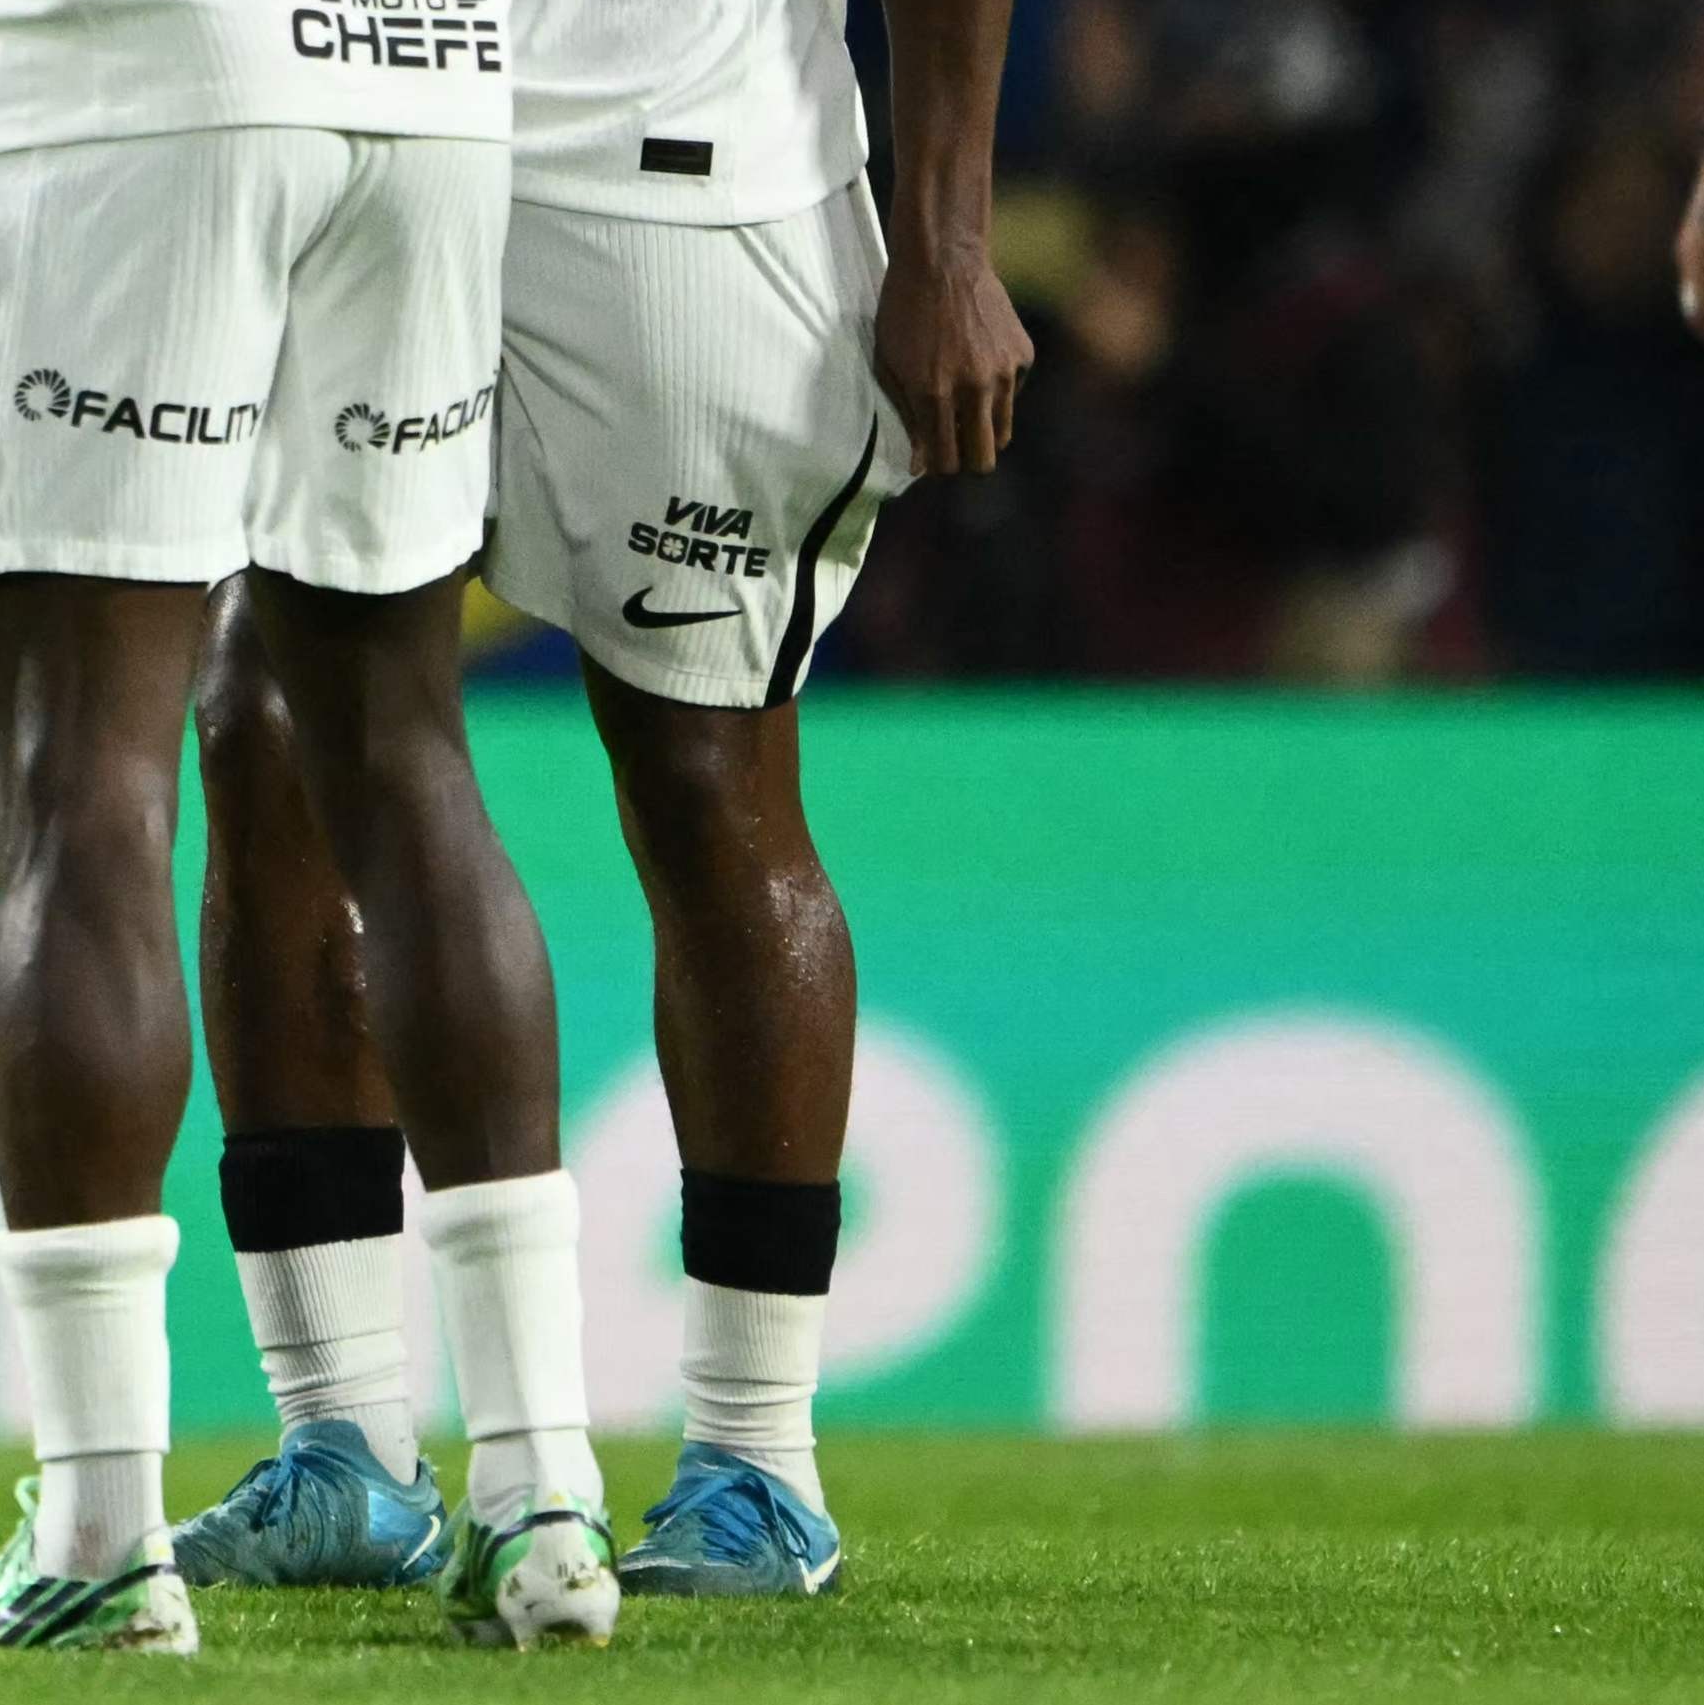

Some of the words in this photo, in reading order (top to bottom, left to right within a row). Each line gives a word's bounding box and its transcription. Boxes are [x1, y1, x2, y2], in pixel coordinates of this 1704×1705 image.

[292, 9, 502, 73] CHEFE
[71, 389, 267, 445] FACILITY
[664, 496, 753, 540] VIVA
[628, 522, 771, 578] SORTE
